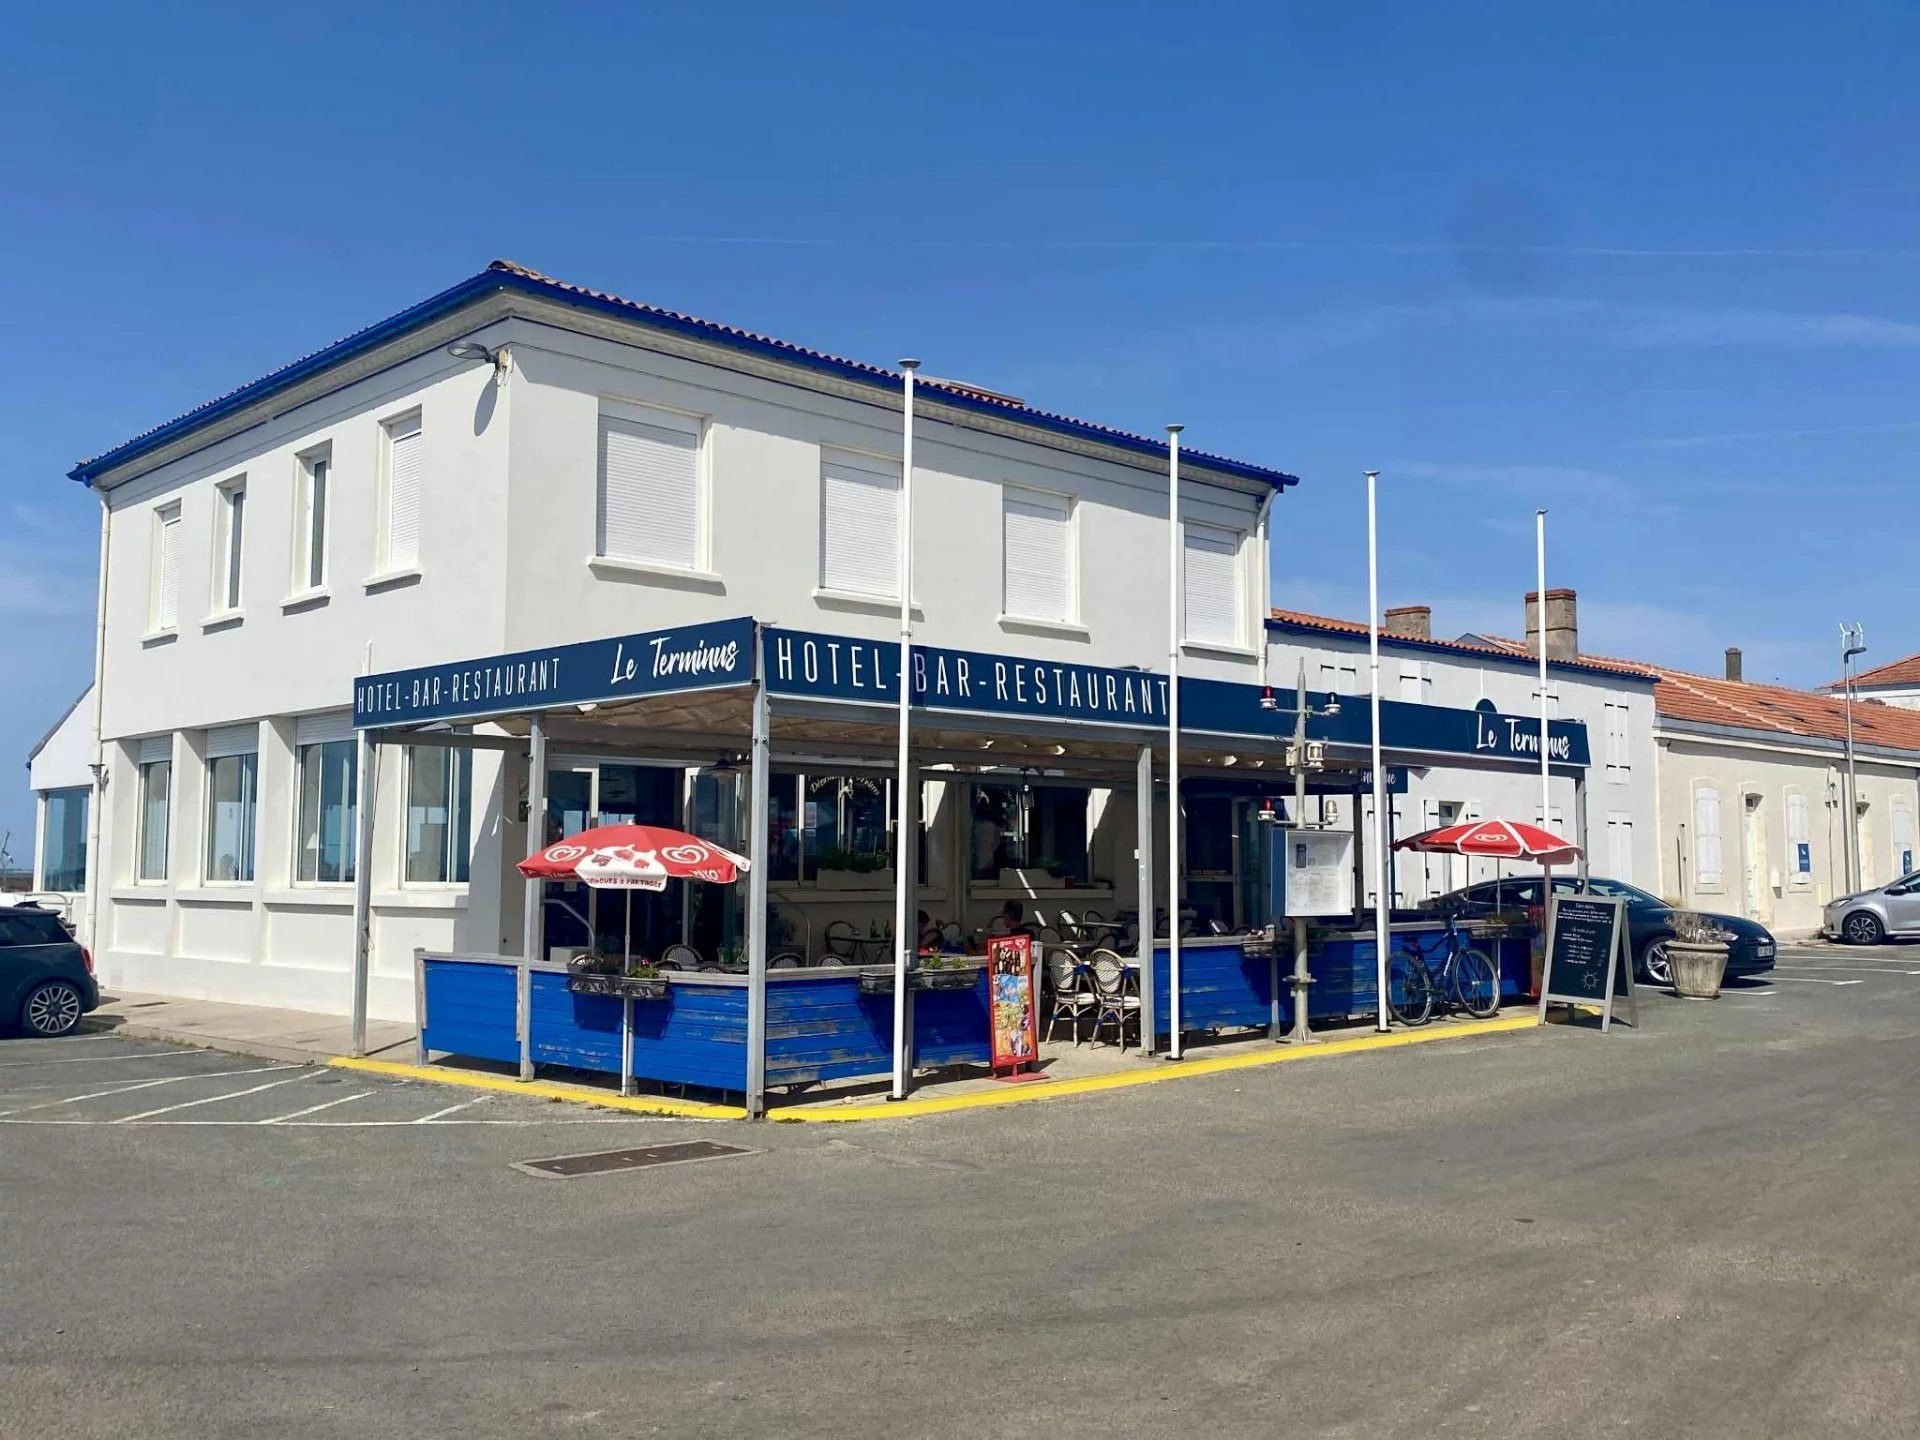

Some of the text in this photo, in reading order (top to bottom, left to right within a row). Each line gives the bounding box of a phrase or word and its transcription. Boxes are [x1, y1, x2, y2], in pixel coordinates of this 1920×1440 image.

[610, 636, 741, 685] Le Terminus
[1476, 713, 1498, 750] Le
